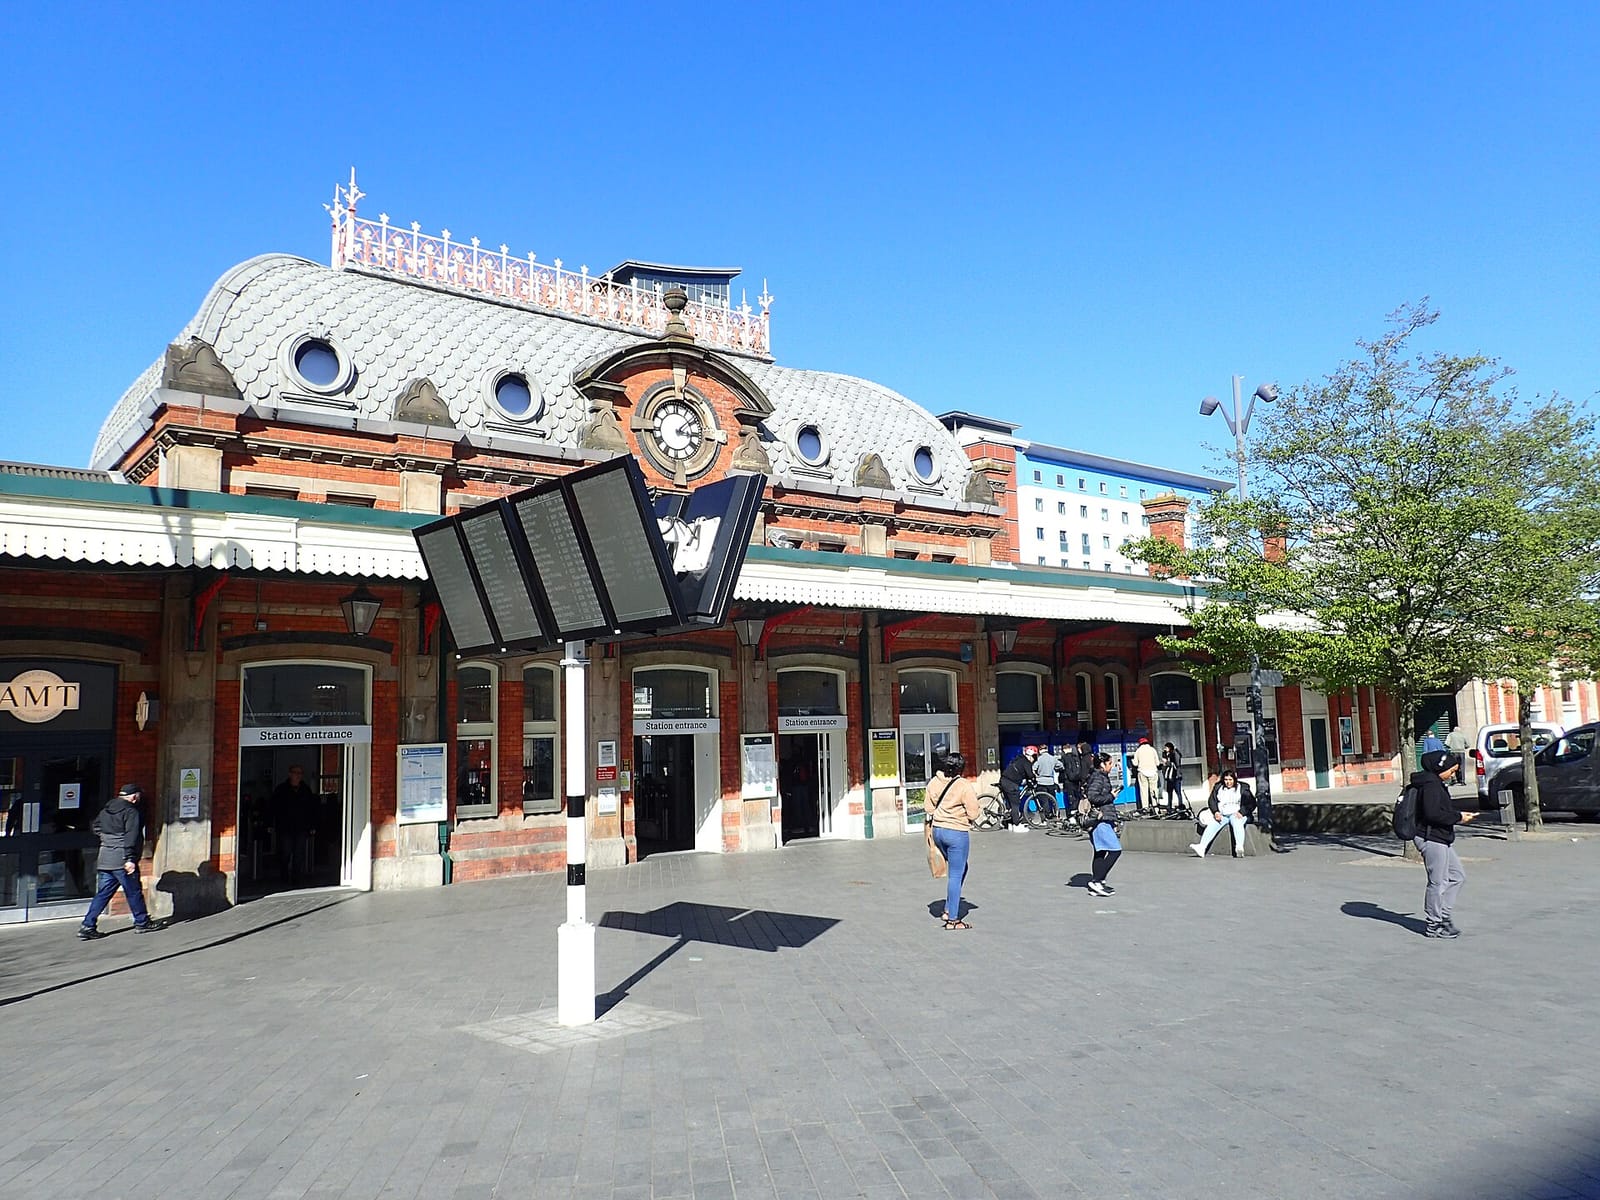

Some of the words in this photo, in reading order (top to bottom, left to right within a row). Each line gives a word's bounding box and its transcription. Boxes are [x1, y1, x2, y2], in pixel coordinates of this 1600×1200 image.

[0, 685, 77, 707] AMT
[645, 722, 674, 730] Station
[785, 718, 809, 727] Station
[260, 730, 302, 740] Station
[304, 730, 353, 739] entrance
